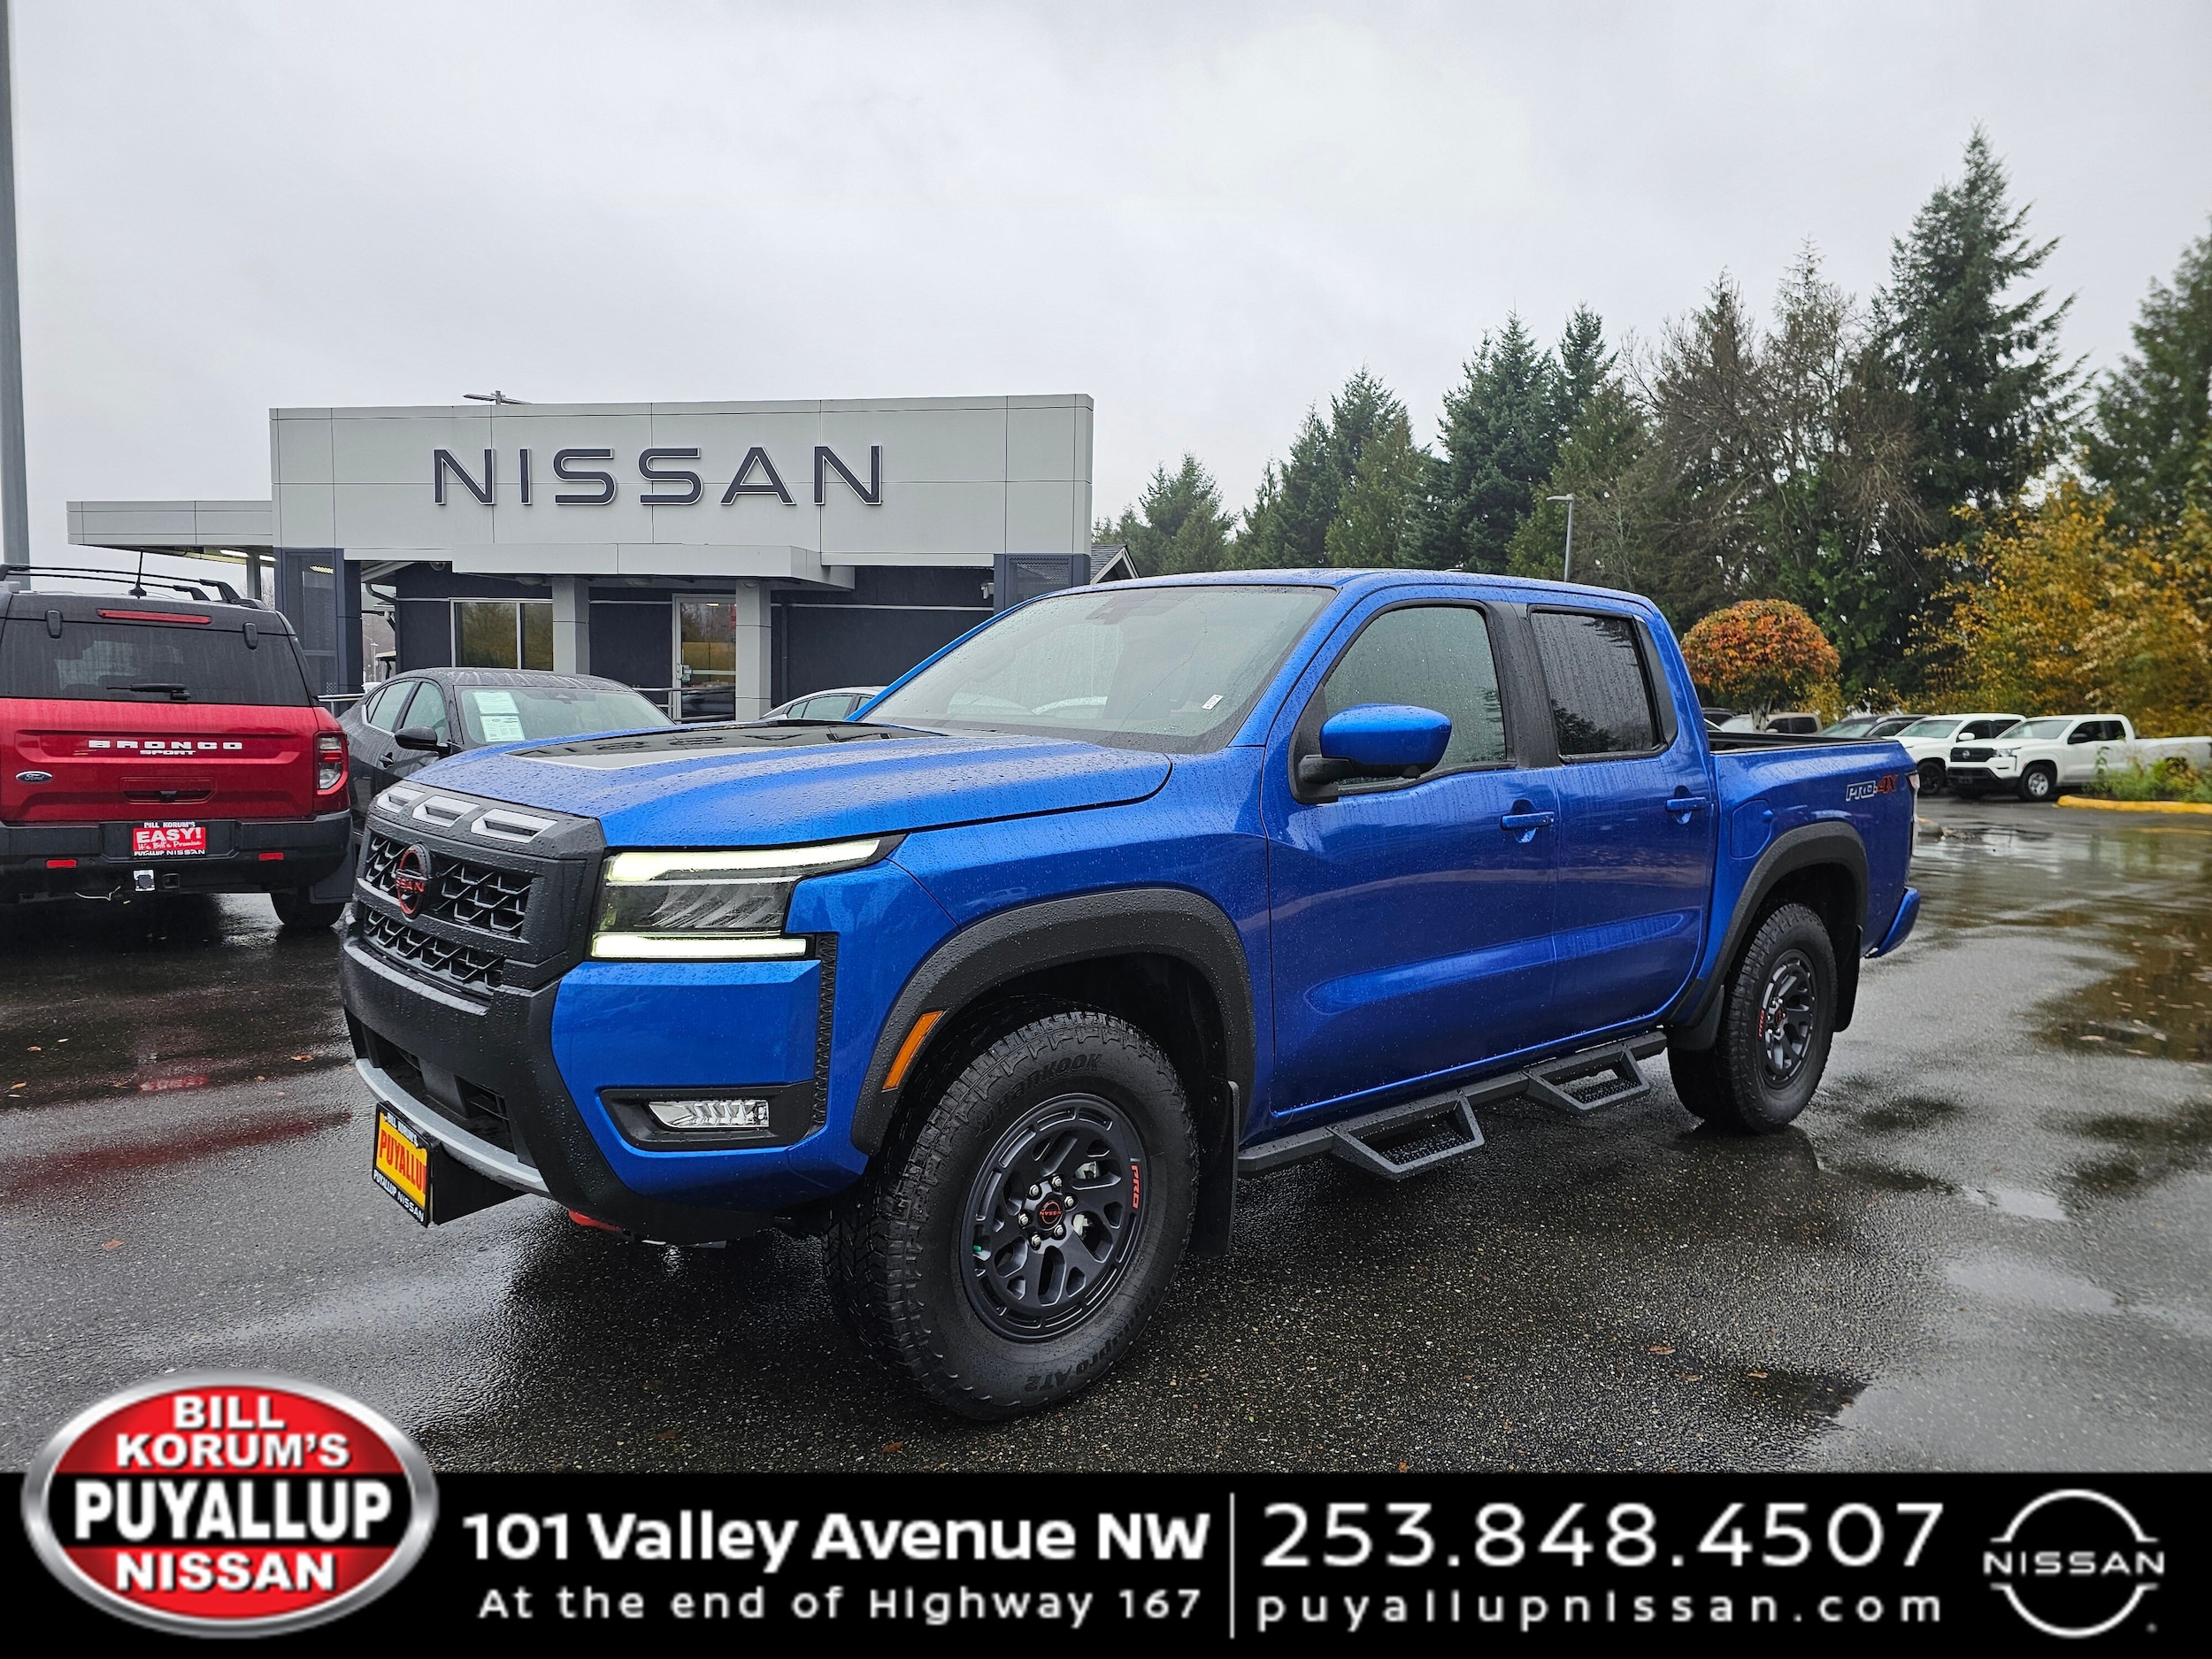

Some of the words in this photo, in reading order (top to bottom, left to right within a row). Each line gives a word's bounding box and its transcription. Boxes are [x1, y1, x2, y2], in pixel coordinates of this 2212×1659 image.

[433, 445, 883, 506] NISSAN
[88, 740, 243, 750] BRONCO
[135, 826, 203, 845] EASY!
[1131, 1164, 1140, 1210] PRO
[397, 1191, 425, 1223] NISSAN
